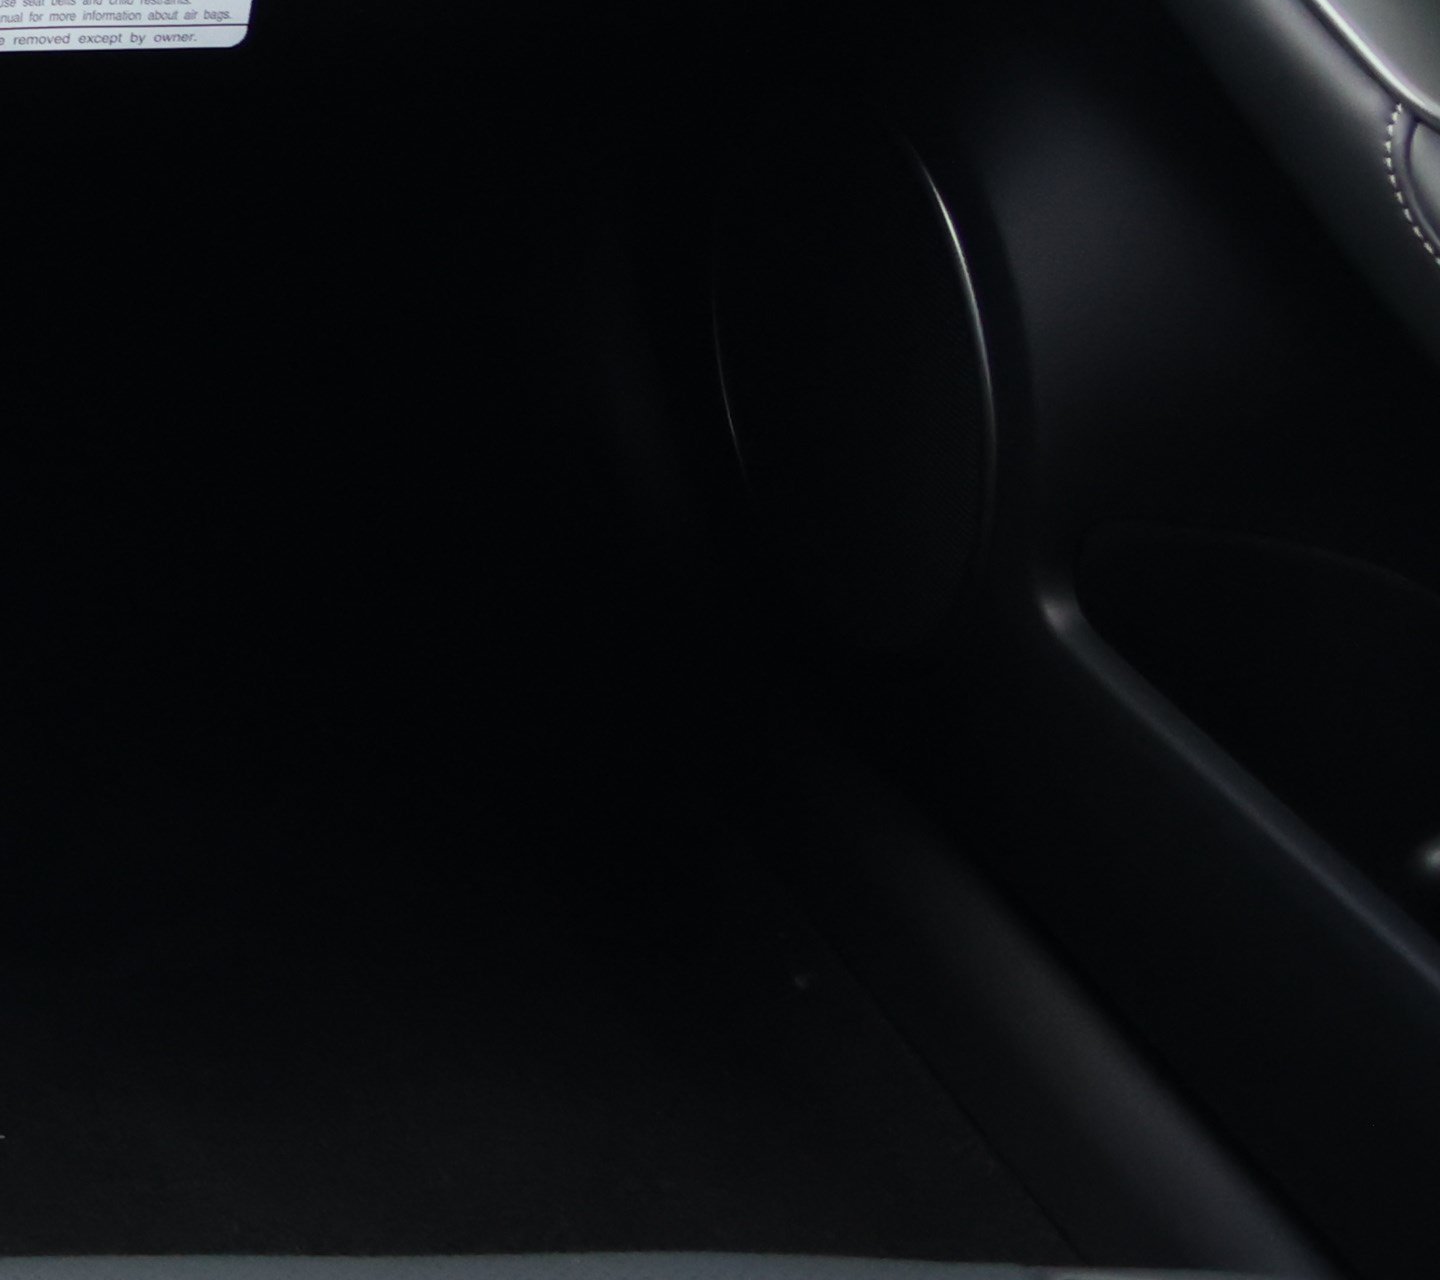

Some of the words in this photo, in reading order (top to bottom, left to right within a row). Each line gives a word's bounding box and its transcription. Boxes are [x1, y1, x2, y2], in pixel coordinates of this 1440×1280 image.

[29, 12, 43, 22] for
[49, 13, 76, 21] more
[83, 10, 142, 21] information
[148, 10, 178, 20] about
[184, 10, 197, 20] air
[204, 9, 231, 22] bags.
[13, 34, 70, 45] removed
[78, 33, 122, 45] except
[131, 32, 145, 44] by
[153, 33, 198, 42] owner.
